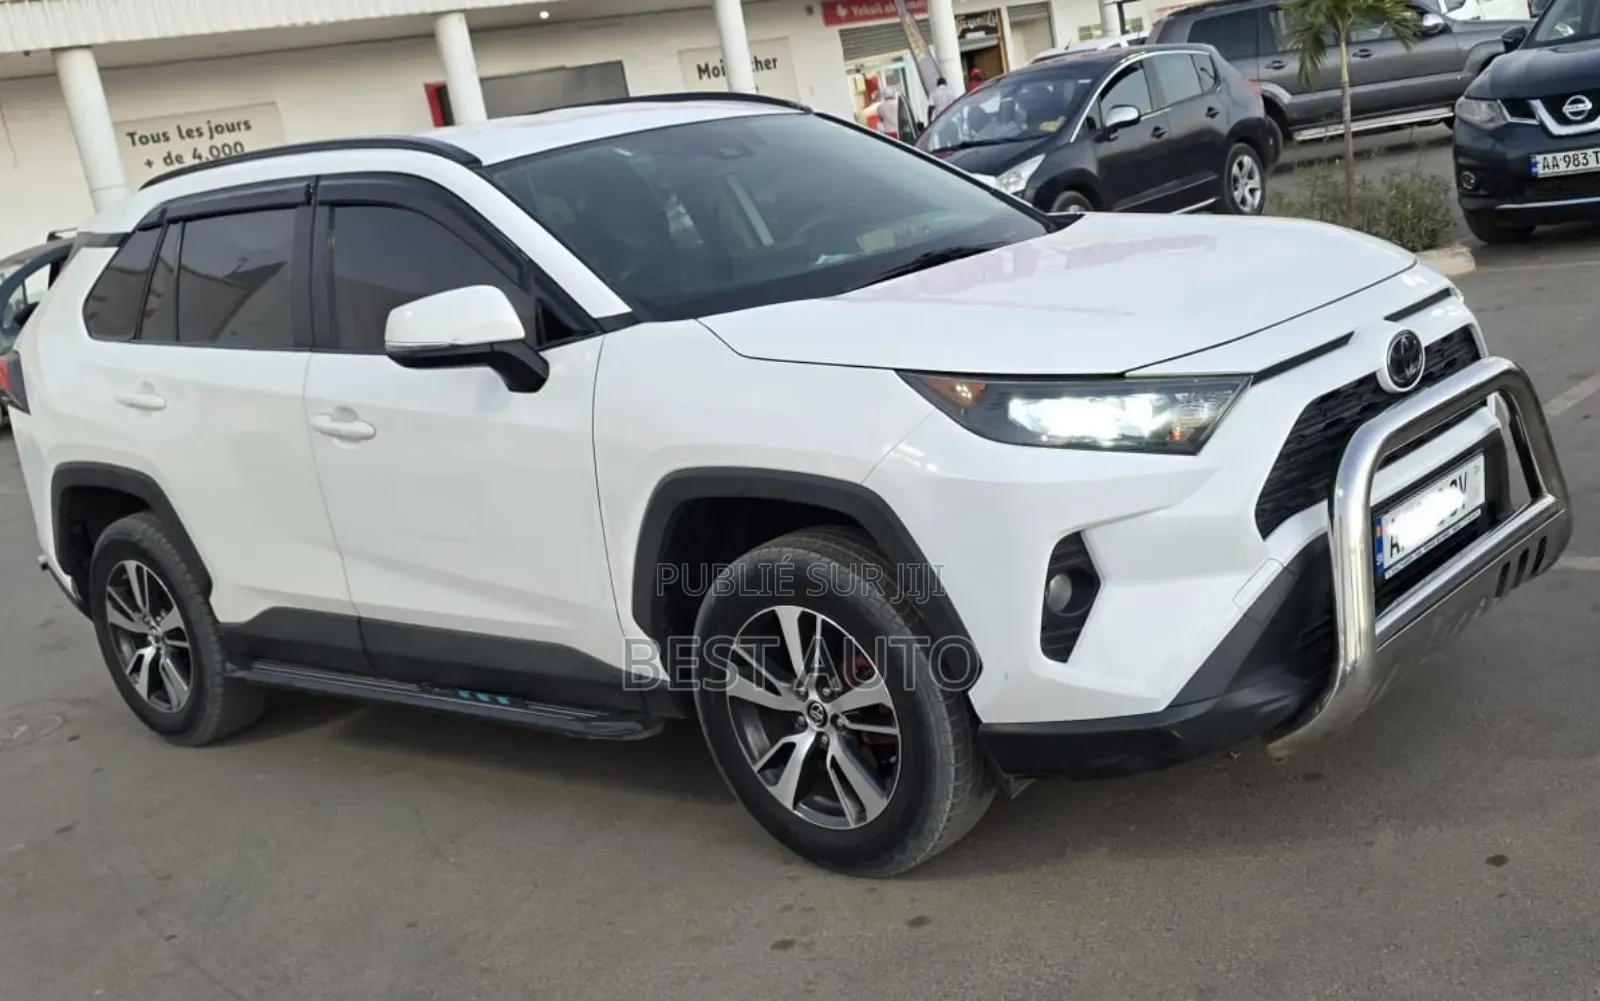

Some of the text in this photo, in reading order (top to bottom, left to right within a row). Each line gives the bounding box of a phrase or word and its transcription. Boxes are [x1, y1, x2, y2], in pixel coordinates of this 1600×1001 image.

[696, 55, 778, 80] Moi her
[126, 118, 252, 148] Tous les jours
[163, 151, 185, 167] de
[192, 141, 245, 162] 4.000
[1563, 152, 1589, 169] 983
